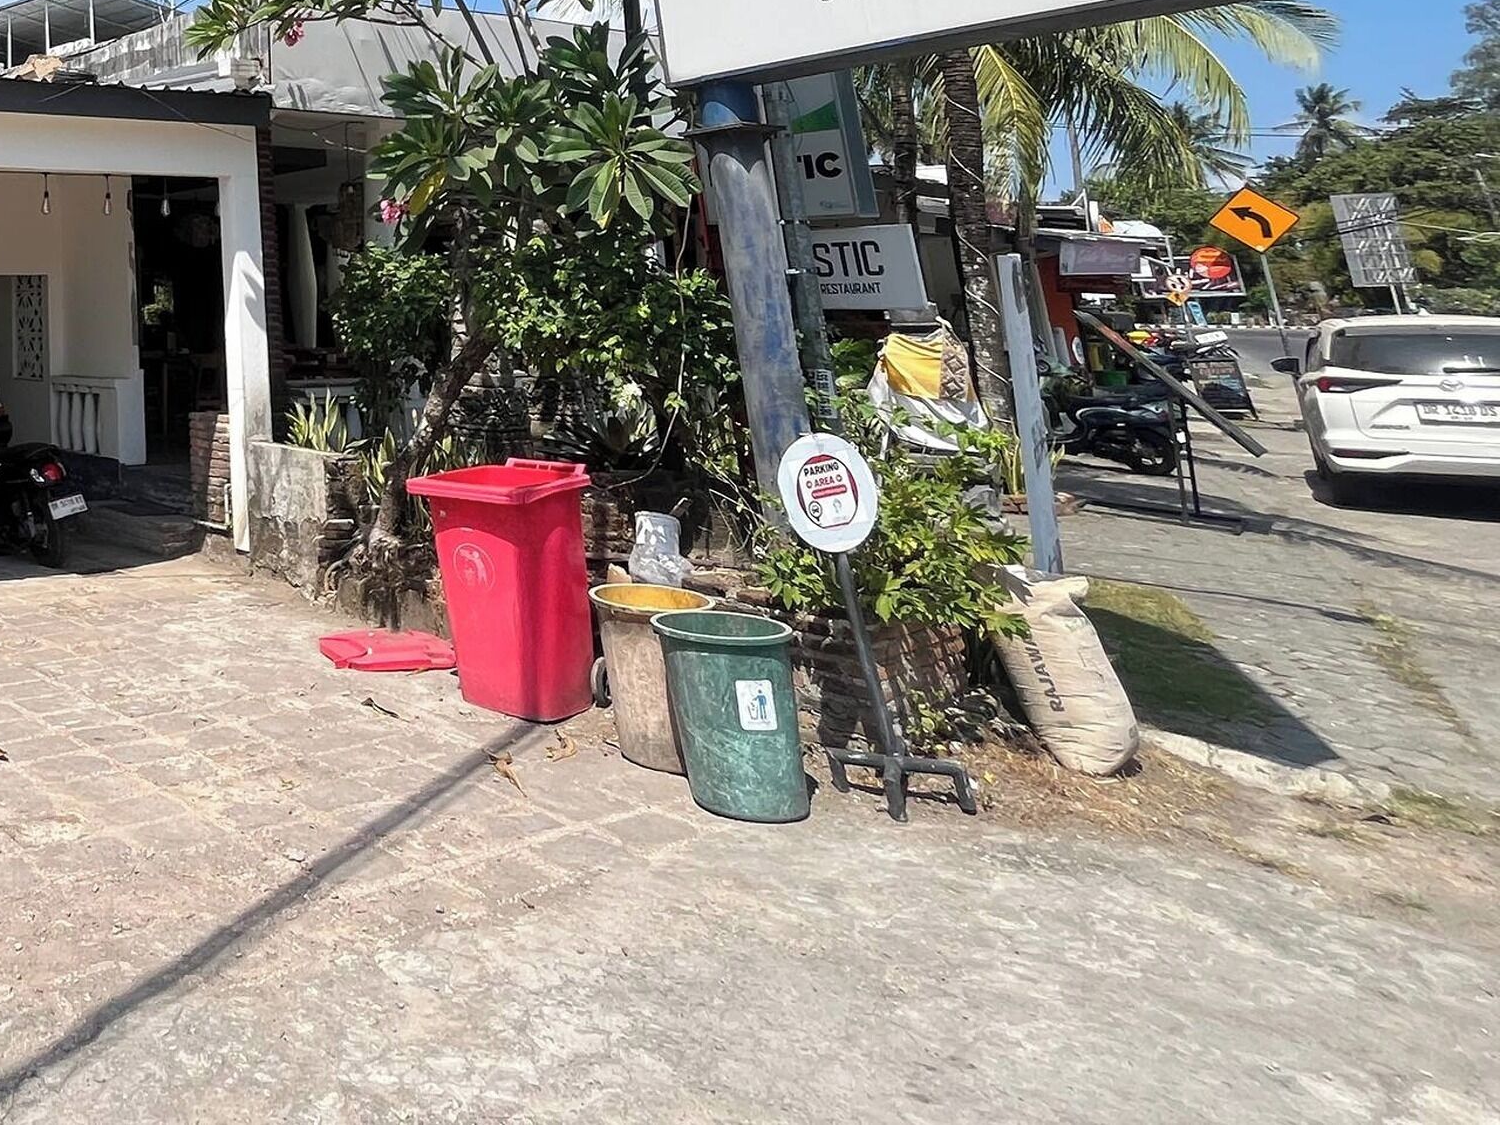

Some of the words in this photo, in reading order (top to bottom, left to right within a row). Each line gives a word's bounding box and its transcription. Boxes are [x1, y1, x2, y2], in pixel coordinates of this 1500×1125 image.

[797, 151, 843, 180] IC
[820, 282, 881, 295] RESTAURANT
[803, 461, 839, 477] PARKING
[813, 477, 835, 488] AREA
